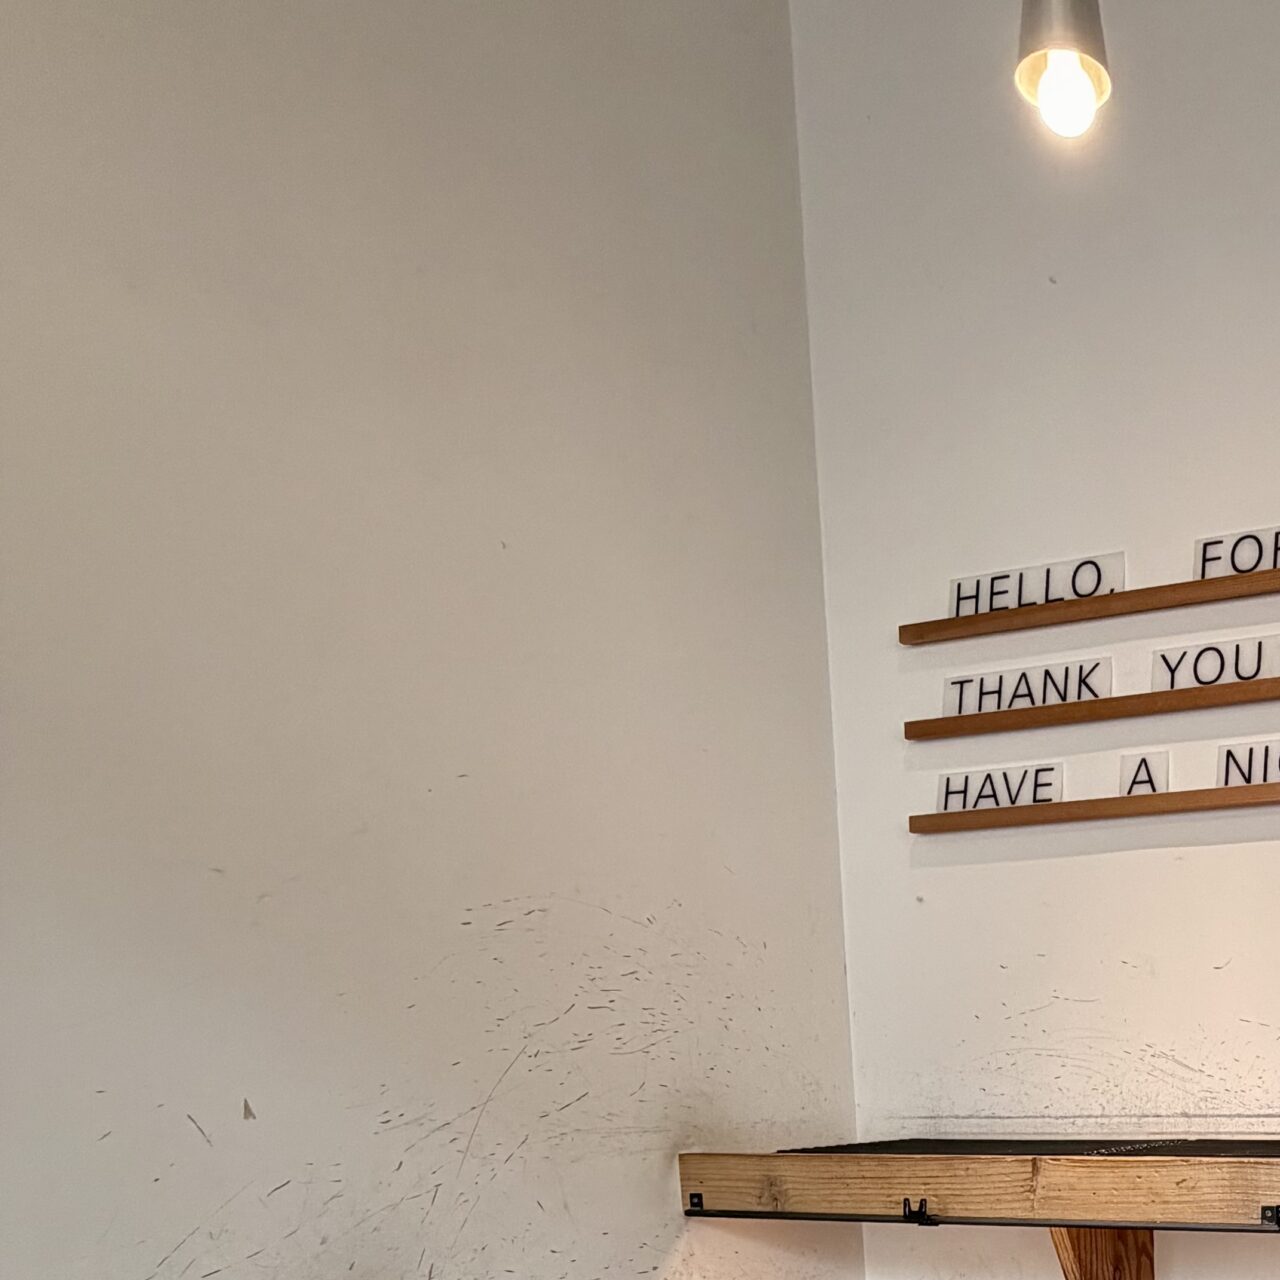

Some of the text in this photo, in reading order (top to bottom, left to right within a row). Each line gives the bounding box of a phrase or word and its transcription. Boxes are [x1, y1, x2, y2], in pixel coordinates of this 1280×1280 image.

[954, 559, 1117, 618] HELLO,
[951, 662, 1101, 717] THANK
[1160, 641, 1264, 690] YOU
[943, 766, 1056, 812] HAVE
[1127, 757, 1158, 795] A
